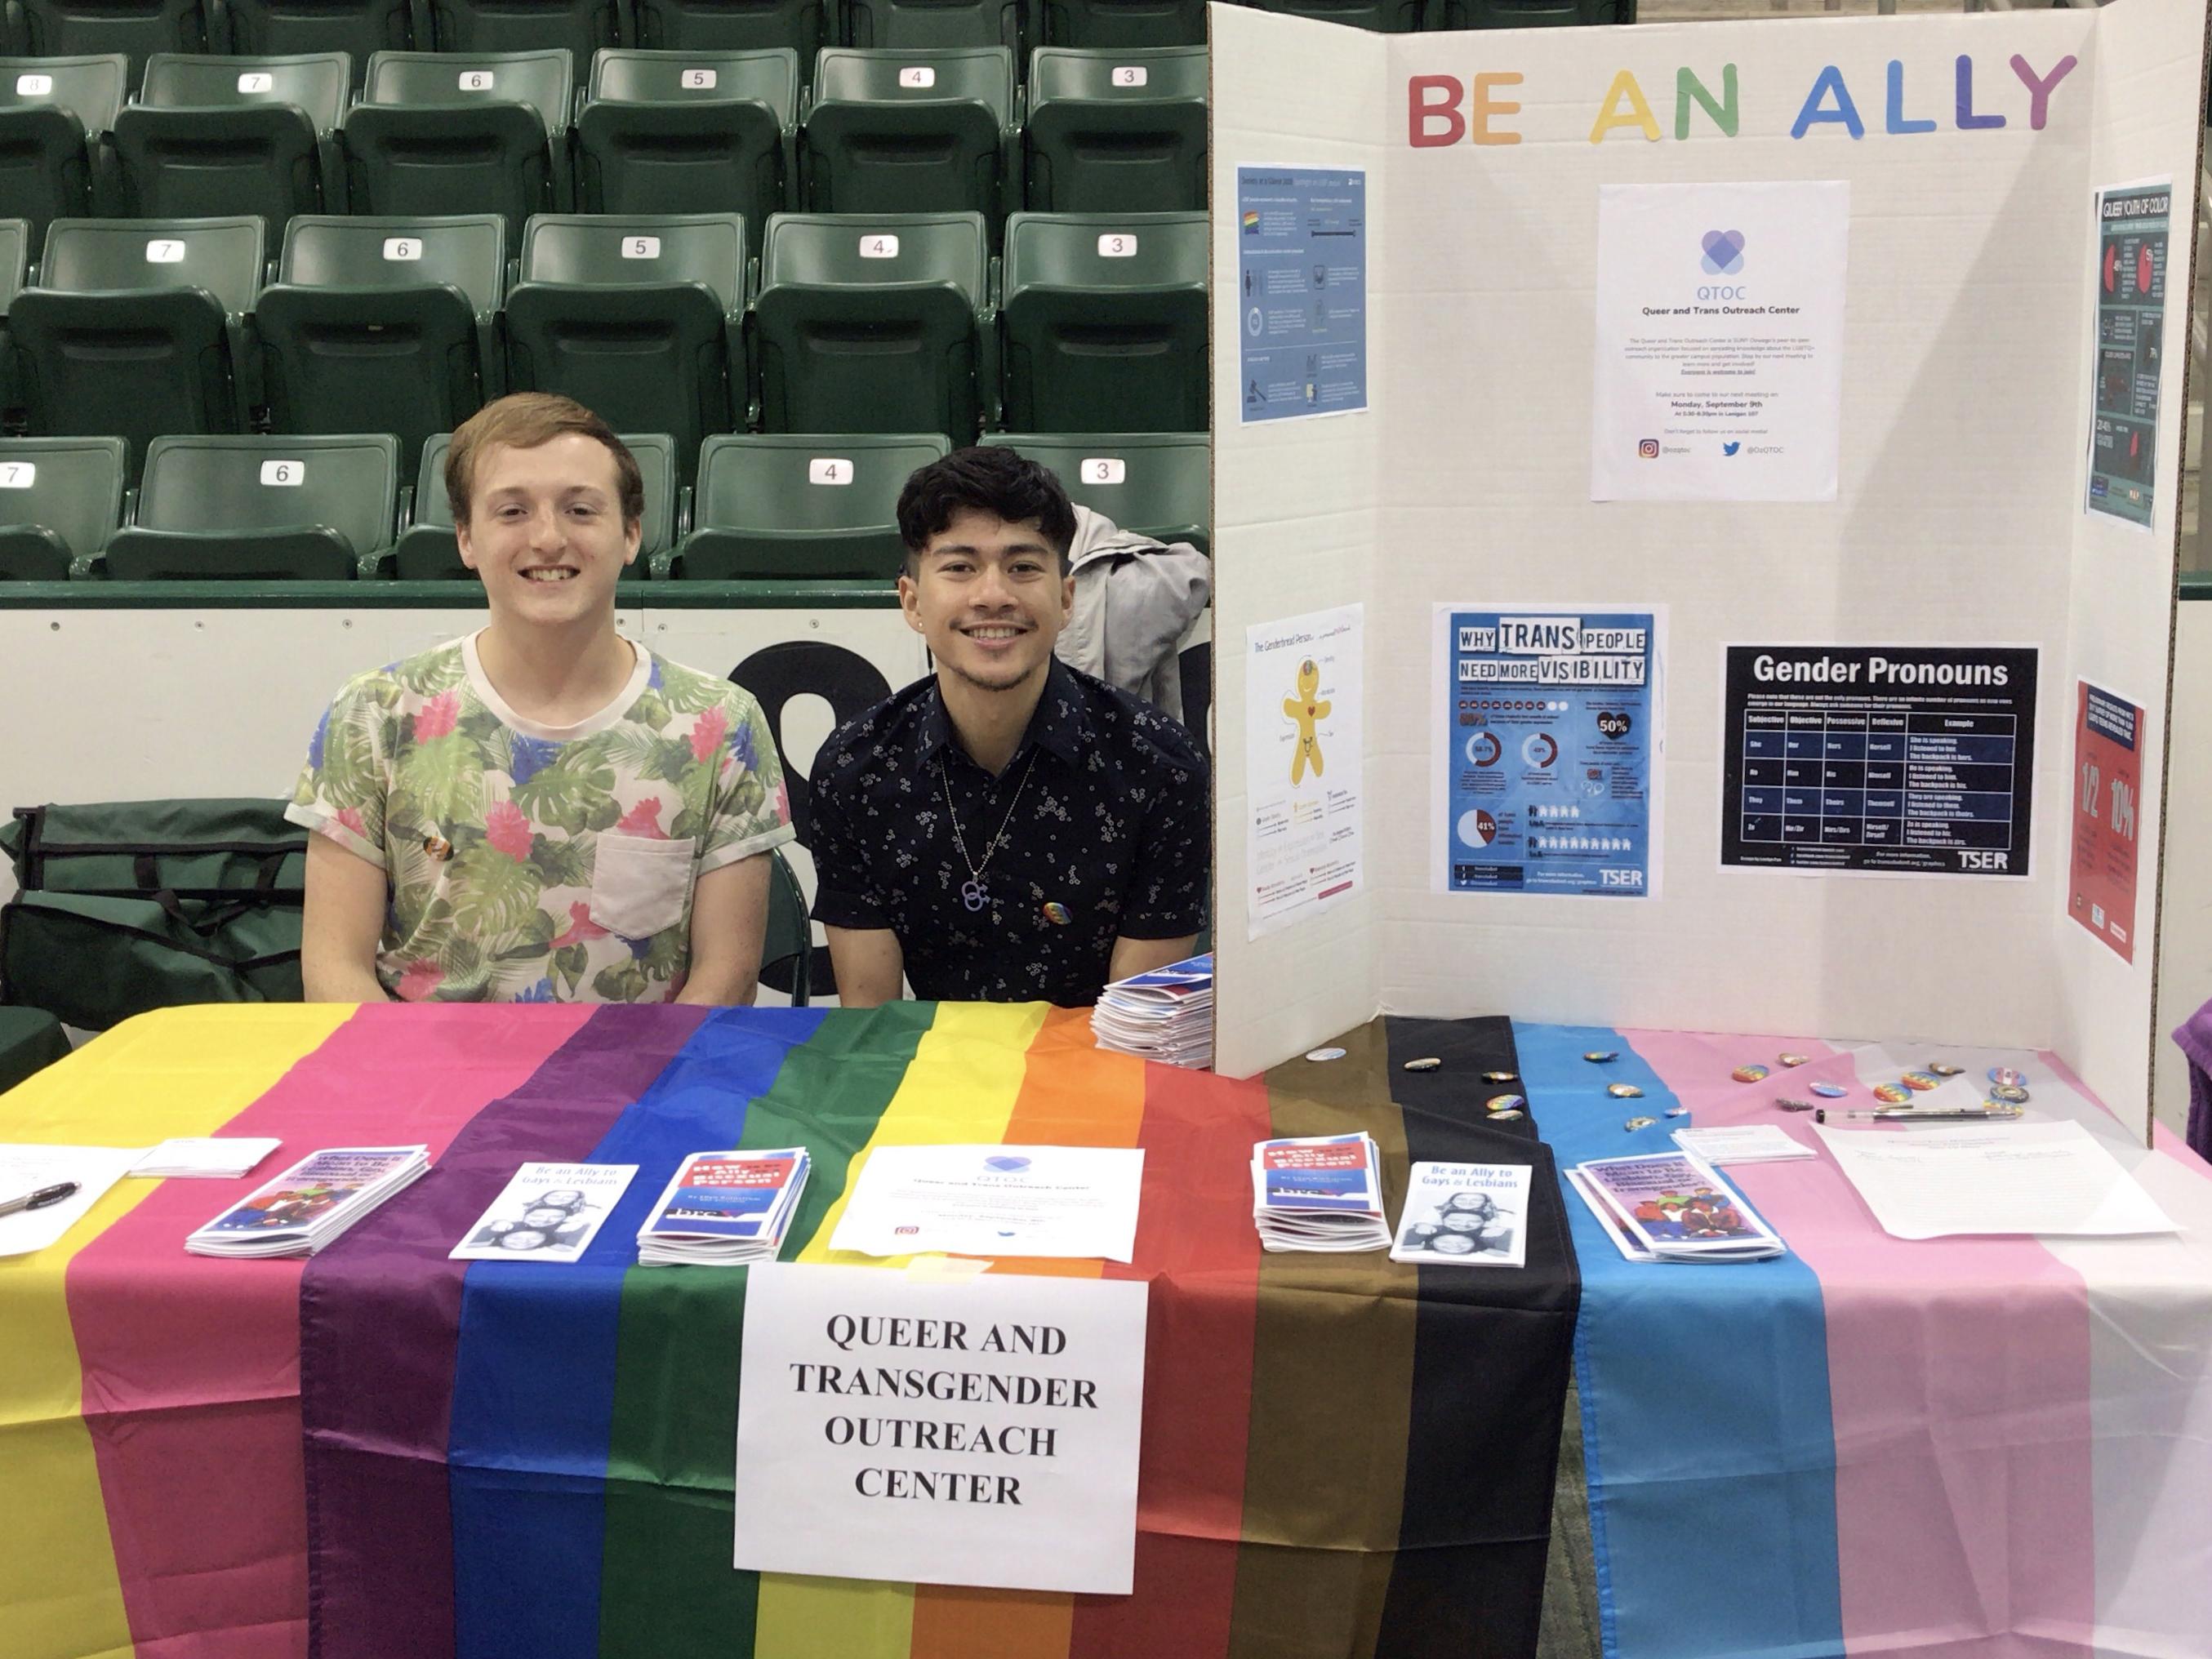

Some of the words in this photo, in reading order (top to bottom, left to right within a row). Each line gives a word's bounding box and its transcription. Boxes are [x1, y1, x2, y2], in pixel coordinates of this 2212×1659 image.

[471, 74, 481, 88] 6
[694, 72, 704, 86] 5
[912, 70, 922, 84] 4
[1125, 69, 1134, 83] 3
[29, 78, 38, 92] 8
[251, 77, 260, 91] 7
[1409, 72, 1524, 149] BE
[1589, 63, 1738, 145] AN
[1790, 54, 2077, 140] ALLY
[2104, 201, 2123, 216] QUEER
[2149, 197, 2169, 213] COLOR
[162, 244, 171, 257] 7
[397, 242, 408, 256] 6
[635, 240, 647, 255] 5
[873, 240, 884, 253] 4
[1112, 238, 1124, 253] 3
[1697, 286, 1746, 300] QTOC
[1643, 307, 1670, 316] Queer
[1673, 306, 1690, 315] and
[1693, 306, 1720, 315] Trans
[1722, 306, 1765, 314] Outreach
[1769, 305, 1800, 314] Center
[7, 466, 19, 483] 7
[276, 465, 289, 482] 6
[825, 465, 837, 480] 4
[1097, 462, 1110, 480] 3
[1461, 631, 1494, 647] WHY
[1501, 623, 1575, 650] TRANS
[1586, 633, 1645, 649] PEOPLE
[1461, 662, 1496, 678] NEED
[1500, 663, 1538, 678] MORE
[1541, 660, 1644, 680] VISIBILITY
[1754, 655, 1861, 683] Gender
[1868, 657, 2009, 686] Pronouns
[1600, 720, 1627, 732] 50%
[1748, 715, 1784, 723] Subjective
[1790, 716, 1822, 724] Objective
[1827, 717, 1865, 725] Possessive
[1945, 719, 1974, 727] Example
[1478, 822, 1495, 830] 41%
[1958, 851, 2007, 870] TSER
[1600, 870, 1642, 886] TSER
[536, 1167, 550, 1175] Be
[574, 1168, 599, 1176] Ally
[1431, 1166, 1448, 1174] Be
[1470, 1168, 1494, 1178] Ally
[522, 1176, 550, 1185] Gays
[566, 1176, 617, 1185] Lesbians
[1422, 1176, 1450, 1186] Gays
[1467, 1177, 1518, 1188] Lesbians
[826, 1314, 968, 1351] QUEER
[980, 1323, 1066, 1355] AND
[790, 1363, 1098, 1409] TRANSGENDER
[825, 1416, 1058, 1457] OUTREACH
[856, 1468, 1022, 1505] CENTER
